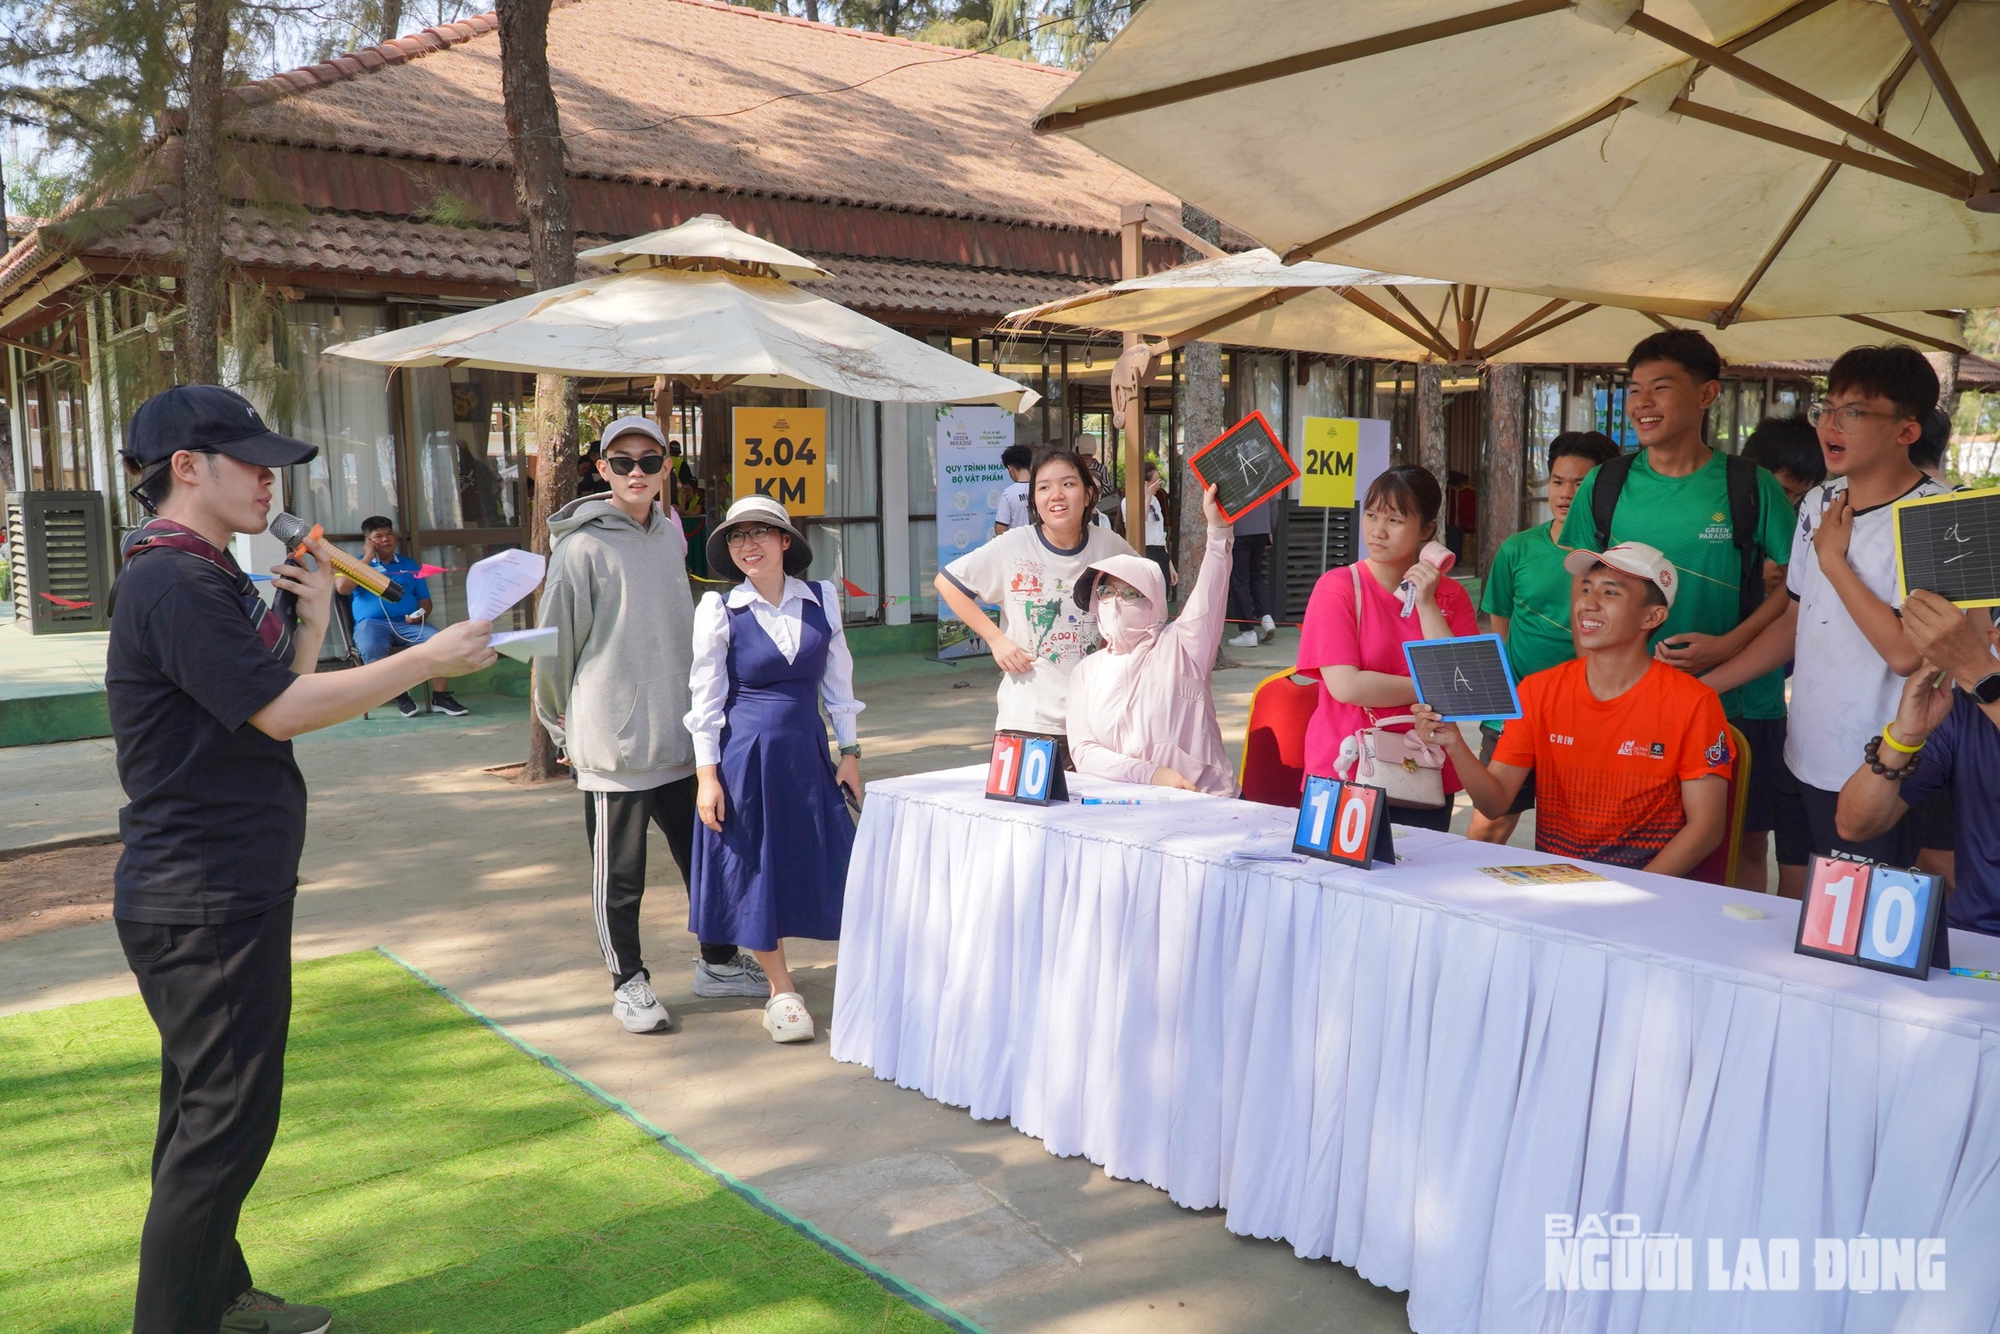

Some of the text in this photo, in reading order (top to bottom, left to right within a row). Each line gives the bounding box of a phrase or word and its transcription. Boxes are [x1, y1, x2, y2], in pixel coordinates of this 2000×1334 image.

[744, 437, 816, 467] 3.04
[1306, 449, 1353, 476] 2KM
[945, 465, 962, 474] QUY
[963, 463, 986, 472] TRÌNH
[951, 474, 963, 485] BỘ
[965, 473, 980, 484] VẬT
[755, 477, 805, 504] KM
[1454, 666, 1474, 692] A
